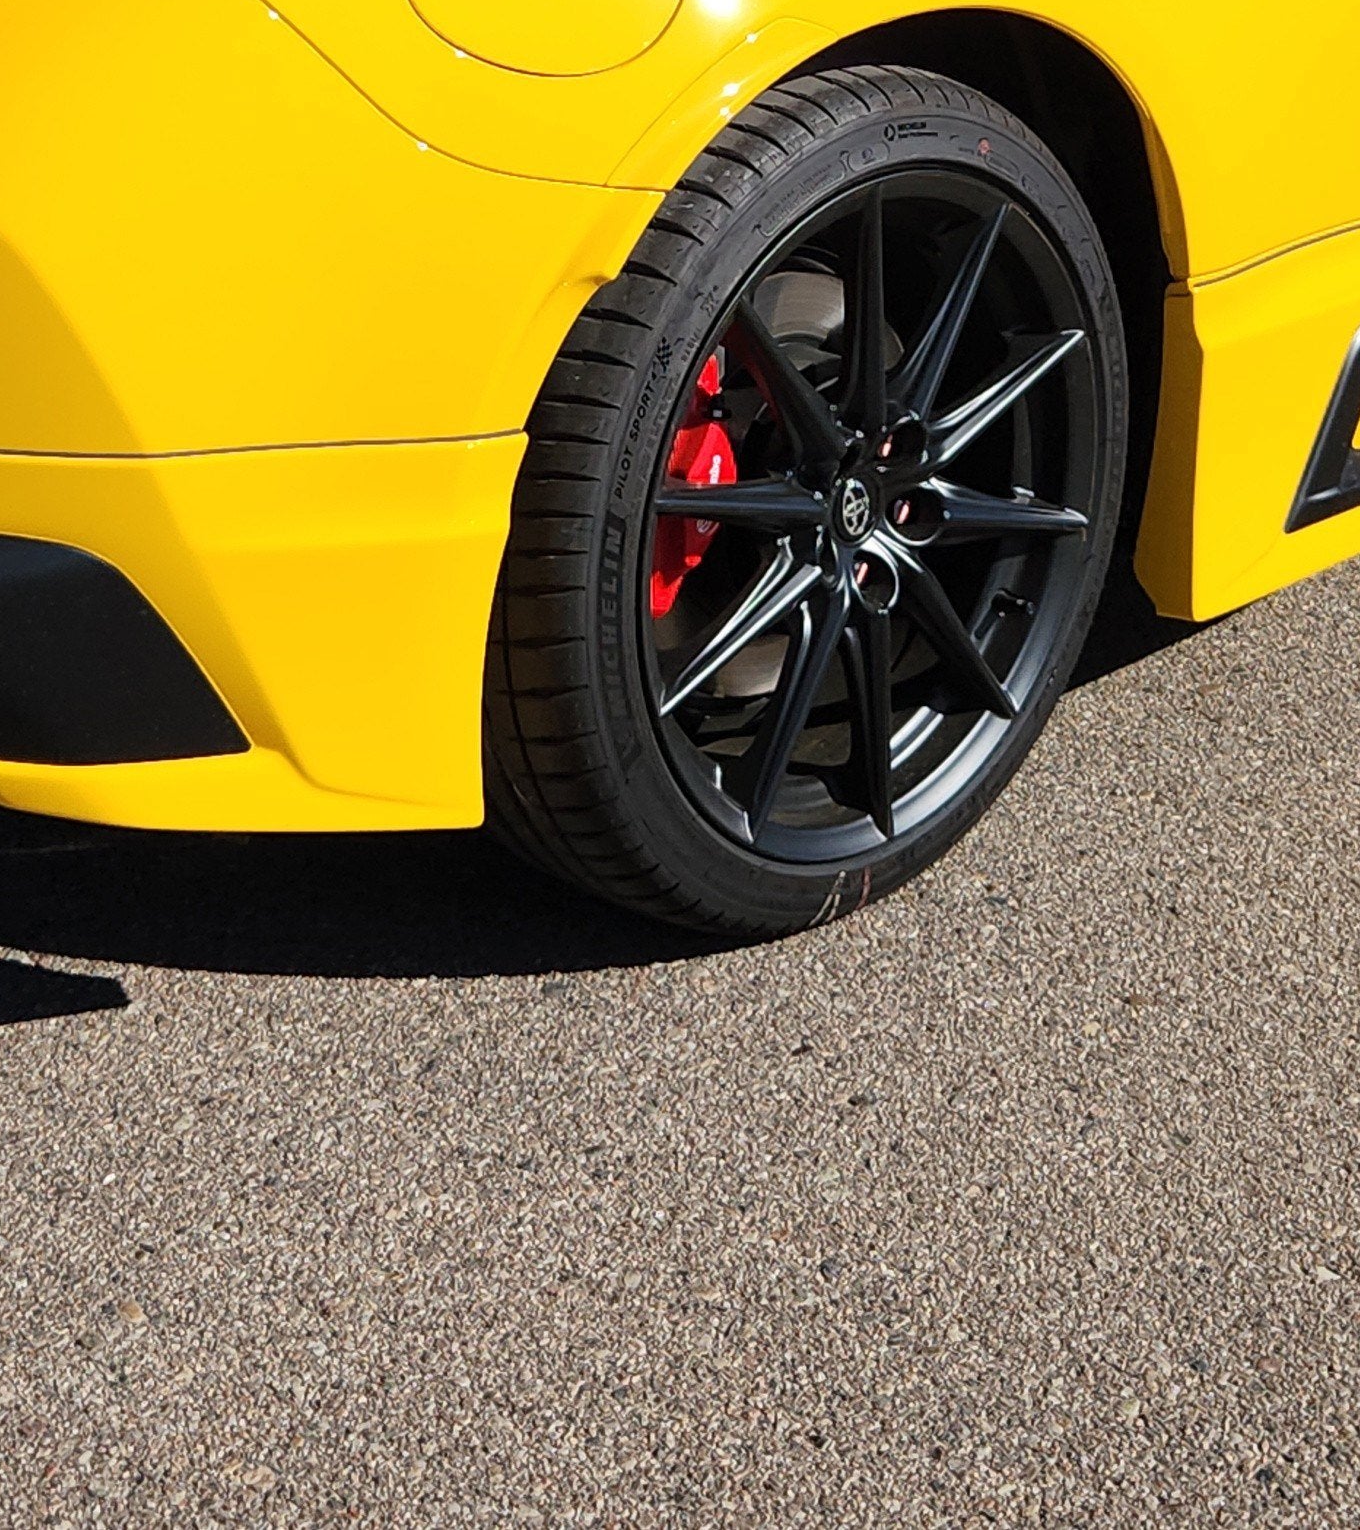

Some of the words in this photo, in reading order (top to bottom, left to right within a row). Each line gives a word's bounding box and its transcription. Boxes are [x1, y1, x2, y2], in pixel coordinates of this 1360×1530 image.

[613, 447, 635, 500] PILOT
[629, 384, 656, 444] SPORT
[599, 527, 630, 716] MICHELIN
